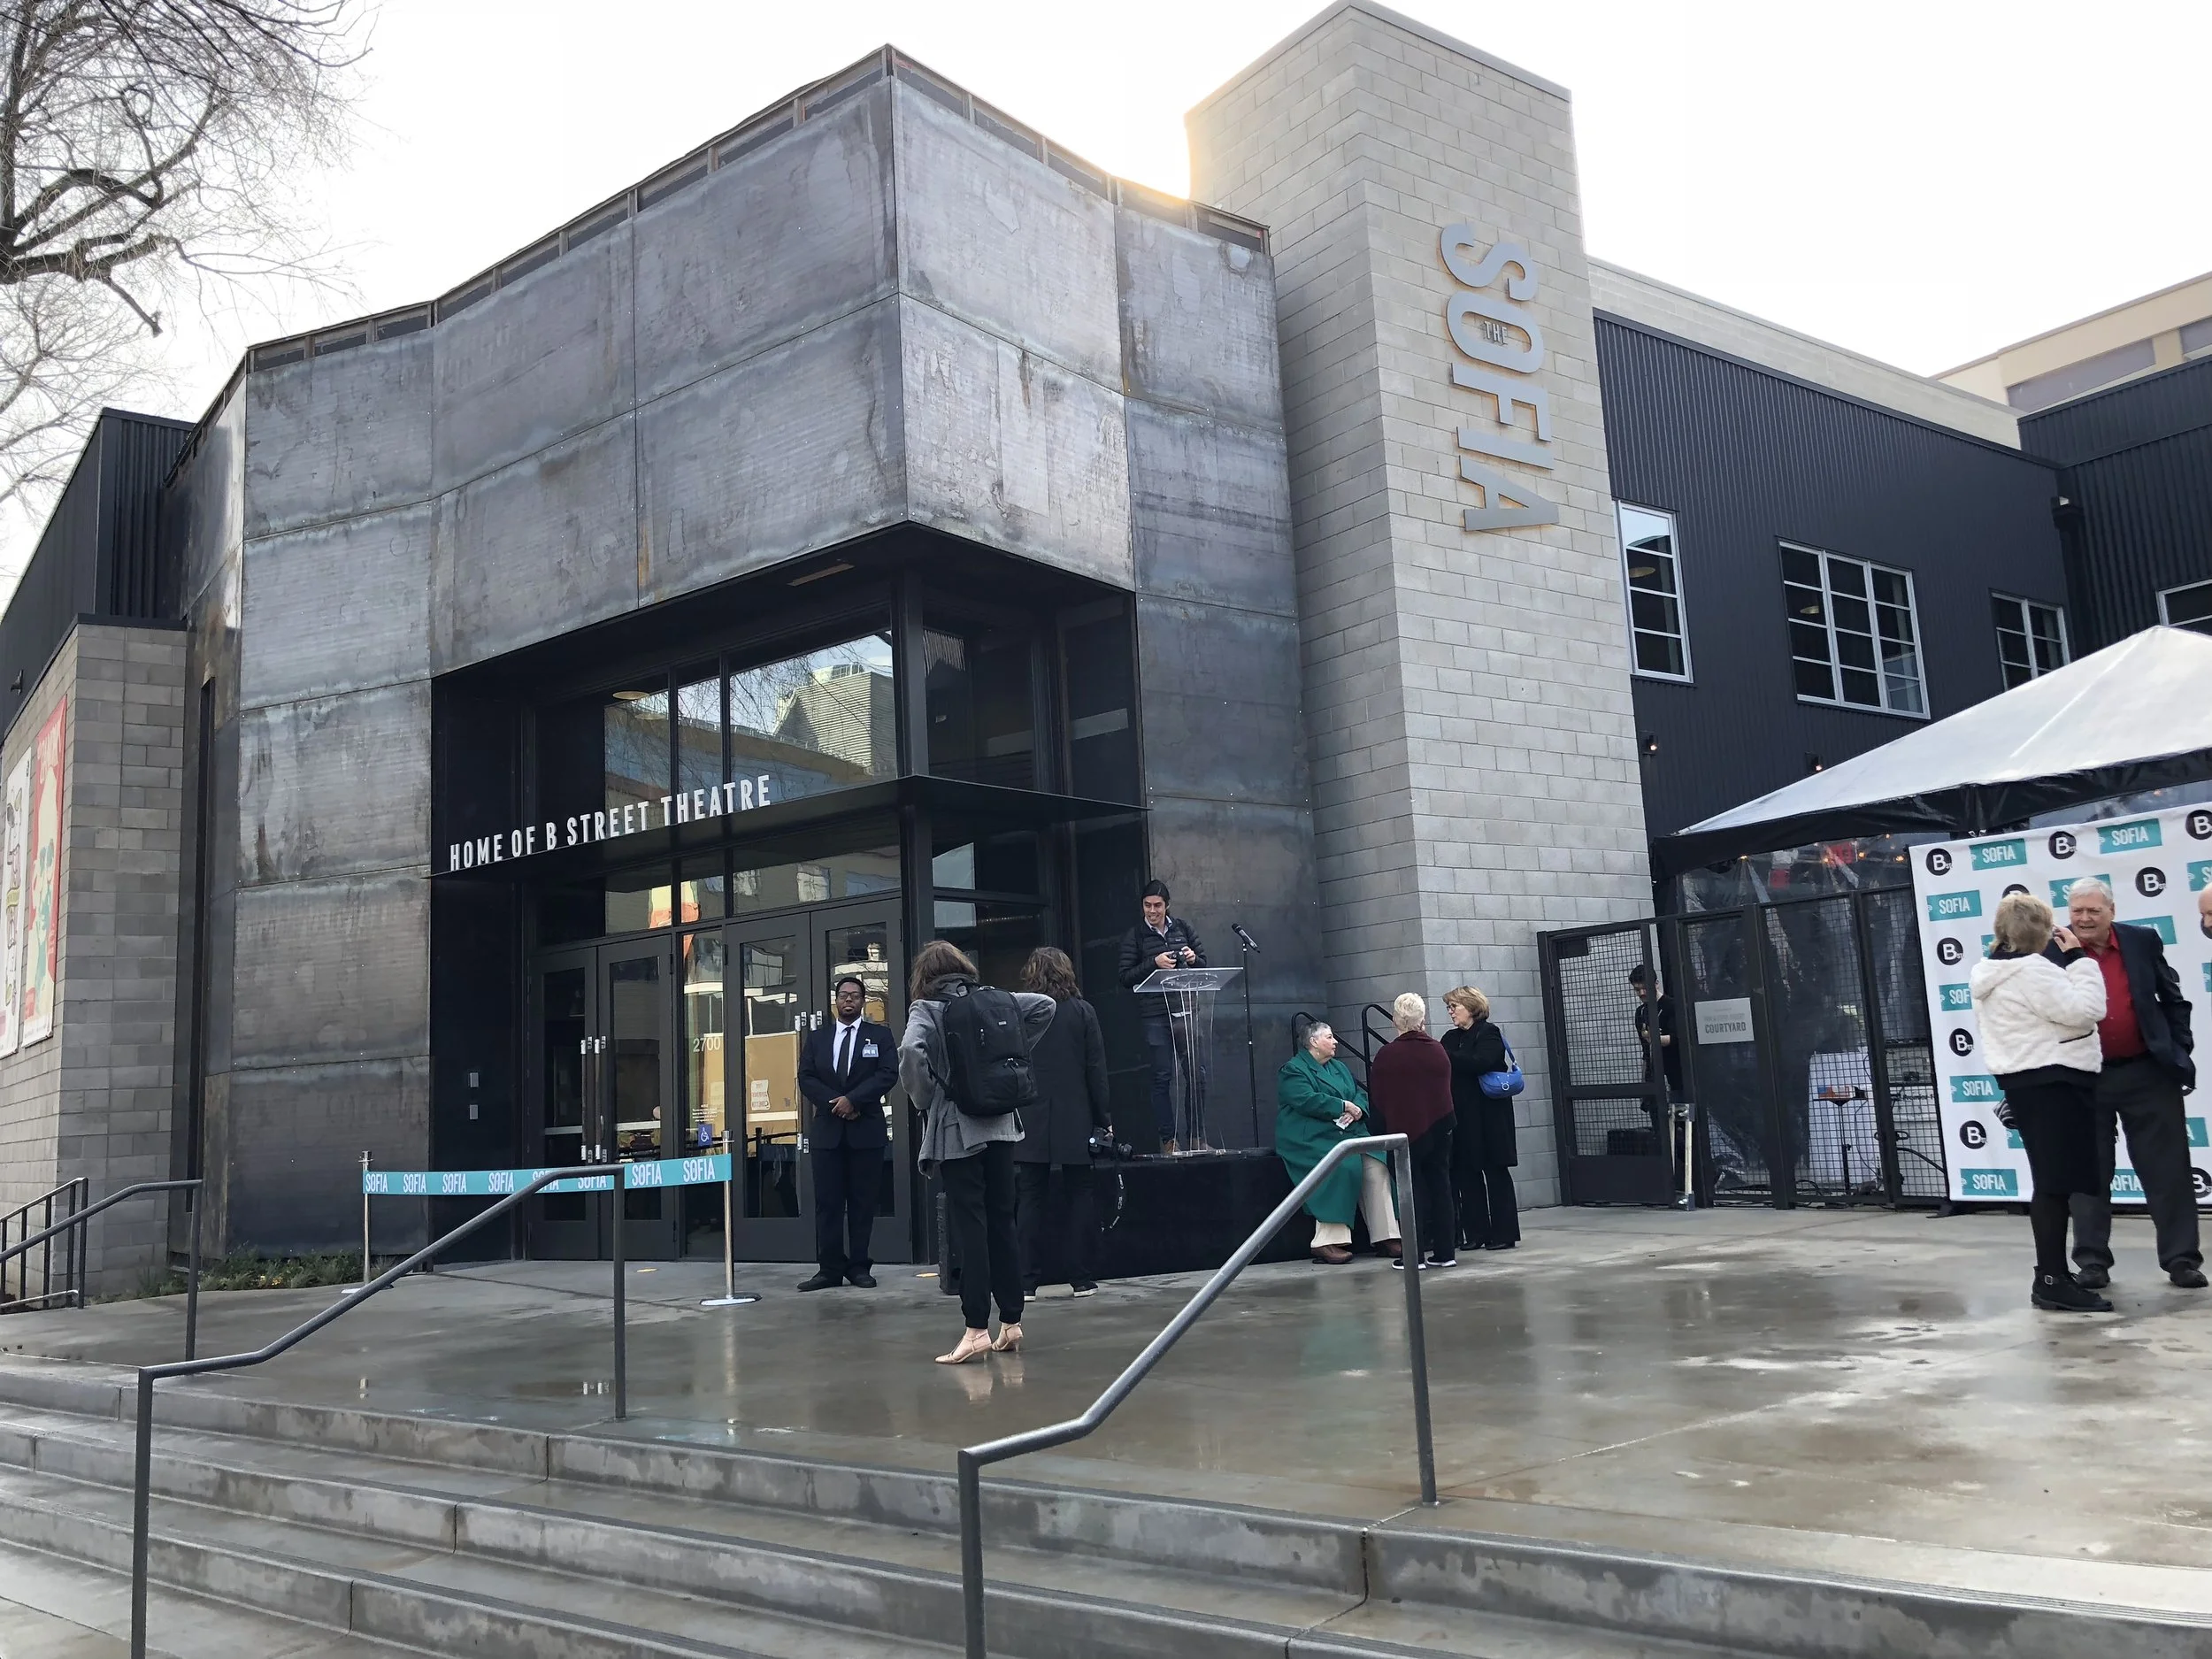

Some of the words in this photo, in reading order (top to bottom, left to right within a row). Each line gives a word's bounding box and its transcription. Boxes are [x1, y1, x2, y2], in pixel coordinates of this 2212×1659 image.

[1484, 320, 1507, 345] THE
[1440, 223, 1559, 531] SOFIA
[449, 833, 503, 872] HOME
[511, 826, 536, 858] OF
[546, 821, 558, 851] B
[566, 801, 649, 847] STREET
[660, 774, 771, 827] THEATRE
[2111, 826, 2149, 847] SOFIA
[1982, 845, 2016, 864] SOFIA
[2055, 837, 2070, 855] B
[1932, 854, 1947, 871] B
[2143, 873, 2158, 892] B
[1939, 896, 1970, 915] SOFIA
[1942, 943, 1957, 960] B
[1949, 988, 1970, 1004] SOF
[1705, 1021, 1747, 1034] COURTYARD
[693, 1037, 721, 1053] 2700
[1955, 1034, 1968, 1051] B
[1962, 1080, 1994, 1096] SOFIA
[1967, 1126, 1981, 1144] B
[365, 1172, 388, 1194] SOFIA
[403, 1172, 426, 1194] SOFIA
[442, 1172, 467, 1194] SOFIA
[488, 1171, 515, 1193] SOFIA
[632, 1163, 662, 1187] SOFIA
[683, 1157, 715, 1182] SOFIA
[1972, 1173, 2006, 1191] SOFIA
[2110, 1174, 2144, 1192] OFIA
